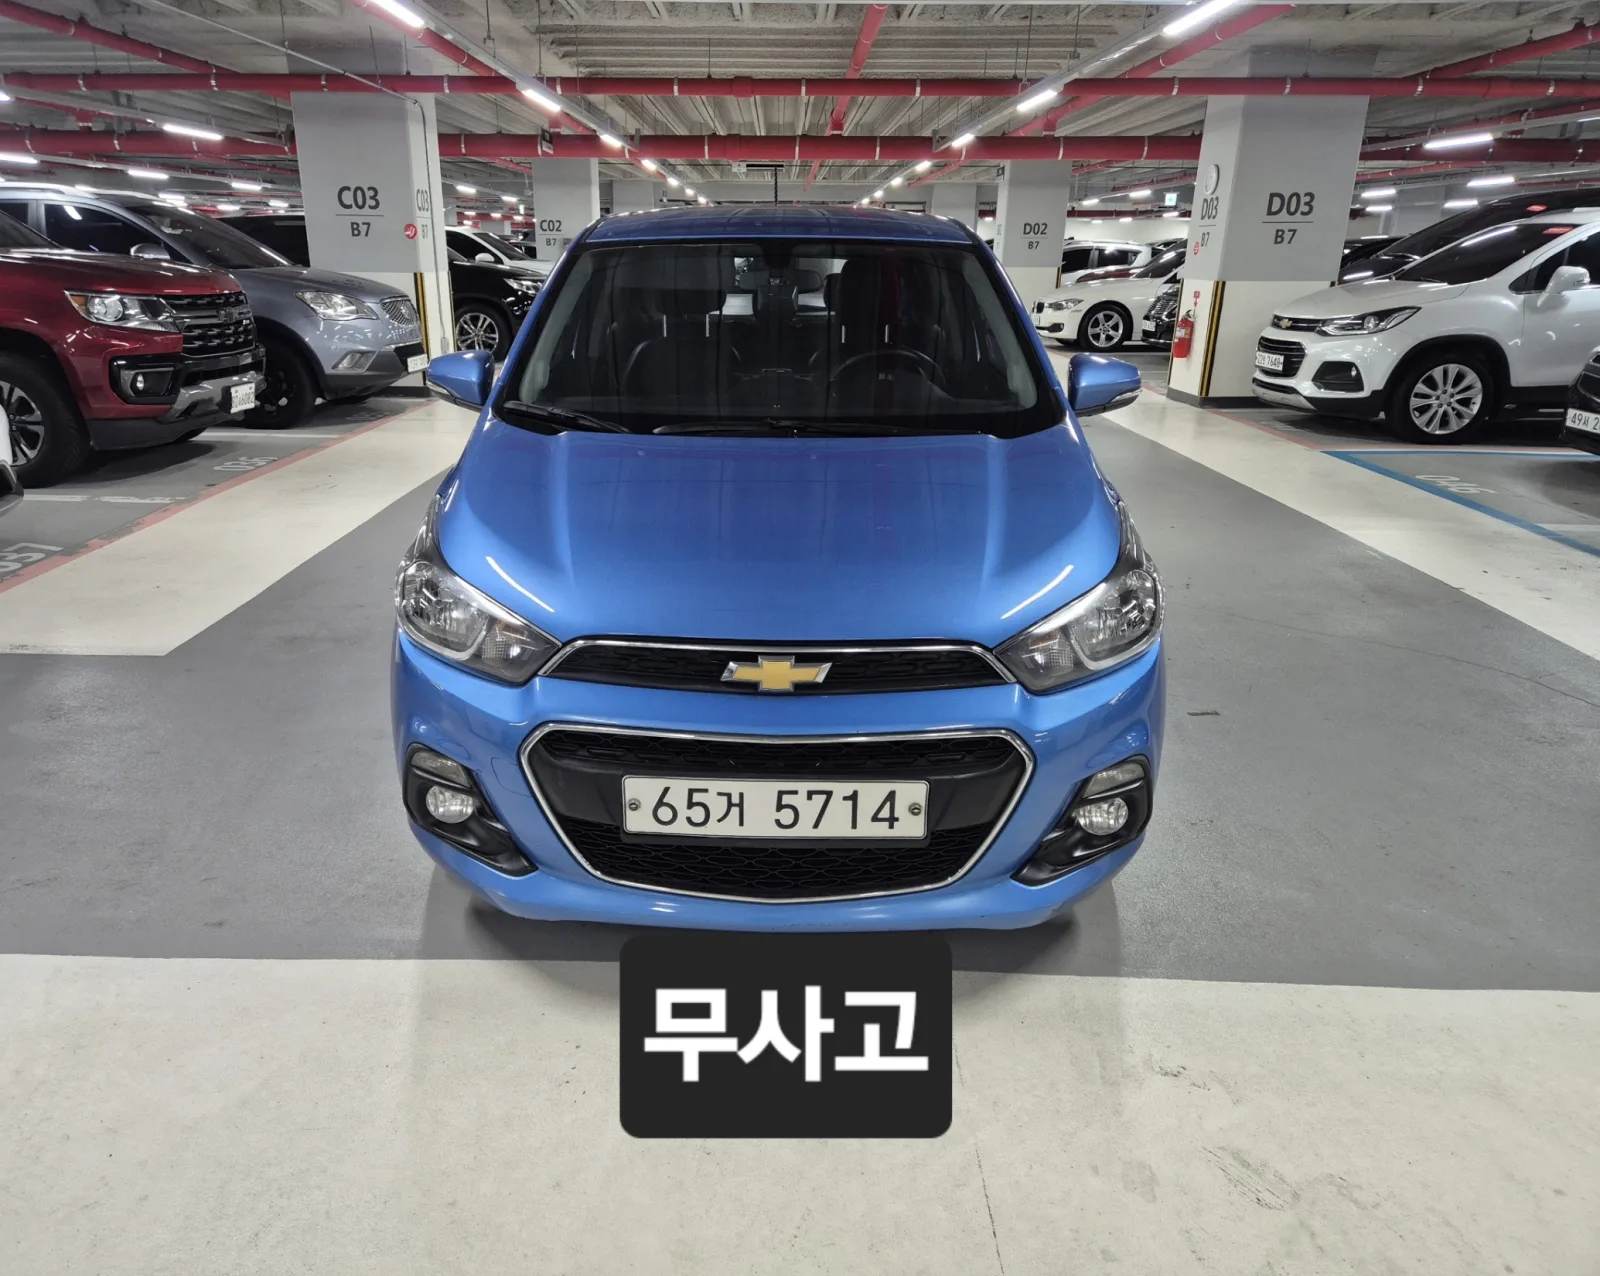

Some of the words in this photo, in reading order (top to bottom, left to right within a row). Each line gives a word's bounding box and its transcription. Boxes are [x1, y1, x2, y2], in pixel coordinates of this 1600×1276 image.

[337, 185, 380, 210] C03
[416, 188, 429, 212] C03
[1266, 191, 1315, 216] D03
[1200, 196, 1219, 220] D03
[350, 221, 371, 237] B7
[540, 219, 562, 232] C02
[1023, 222, 1048, 235] D02
[545, 237, 557, 247] B7
[1200, 231, 1210, 247] B7
[1274, 228, 1298, 245] B7
[1028, 241, 1040, 249] B7
[651, 786, 746, 828] 65거
[773, 789, 901, 831] 5714
